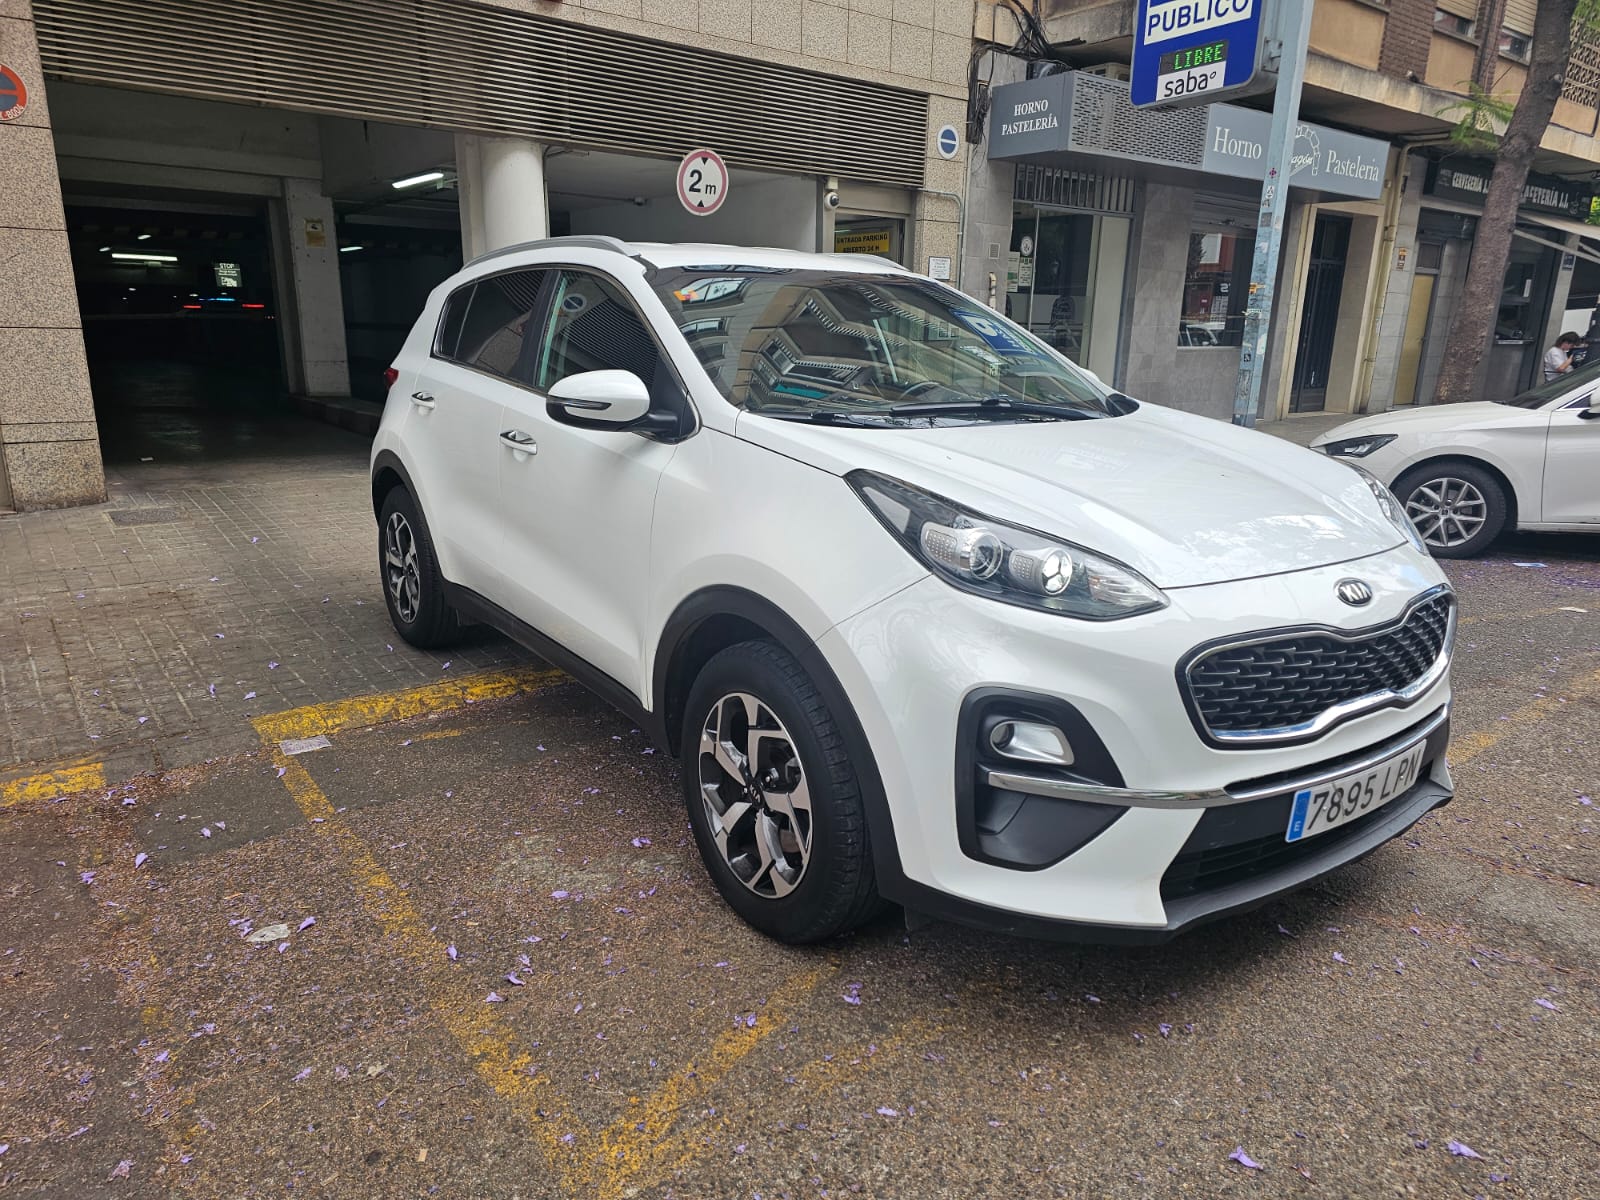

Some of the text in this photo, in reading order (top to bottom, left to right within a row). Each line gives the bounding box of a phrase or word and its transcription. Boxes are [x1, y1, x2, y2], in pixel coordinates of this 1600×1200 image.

[1174, 44, 1224, 70] LIBRE
[1014, 99, 1049, 117] HORNO
[1001, 112, 1059, 136] PASTELERÍA
[1213, 126, 1262, 160] Horno
[688, 168, 717, 196] 2 m
[219, 262, 235, 270] STOP
[1306, 773, 1378, 831] 7895
[1380, 748, 1422, 801] LPN
